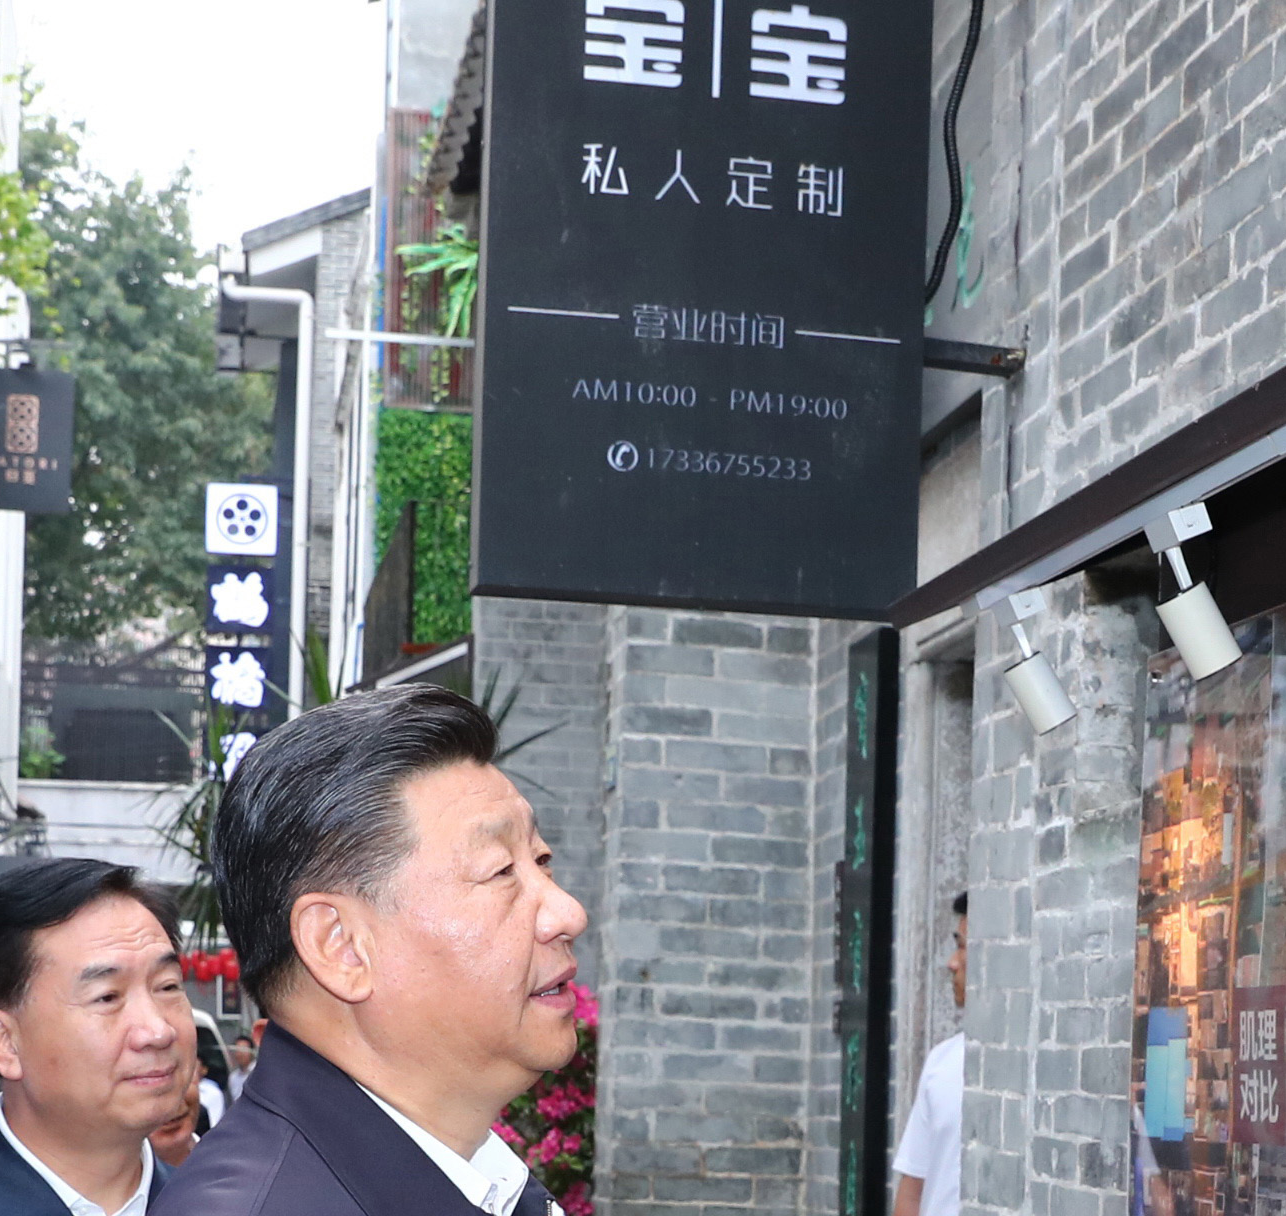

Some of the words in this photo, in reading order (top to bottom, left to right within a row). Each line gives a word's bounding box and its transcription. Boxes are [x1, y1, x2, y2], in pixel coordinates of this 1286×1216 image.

[581, 143, 844, 217] 私人定制
[632, 303, 784, 349] 营业时间
[572, 378, 697, 408] AM10:00
[729, 388, 848, 420] PM19:00
[647, 447, 812, 481] 17336755233
[1239, 1008, 1278, 1061] 肌理
[1239, 1069, 1280, 1124] 对比
